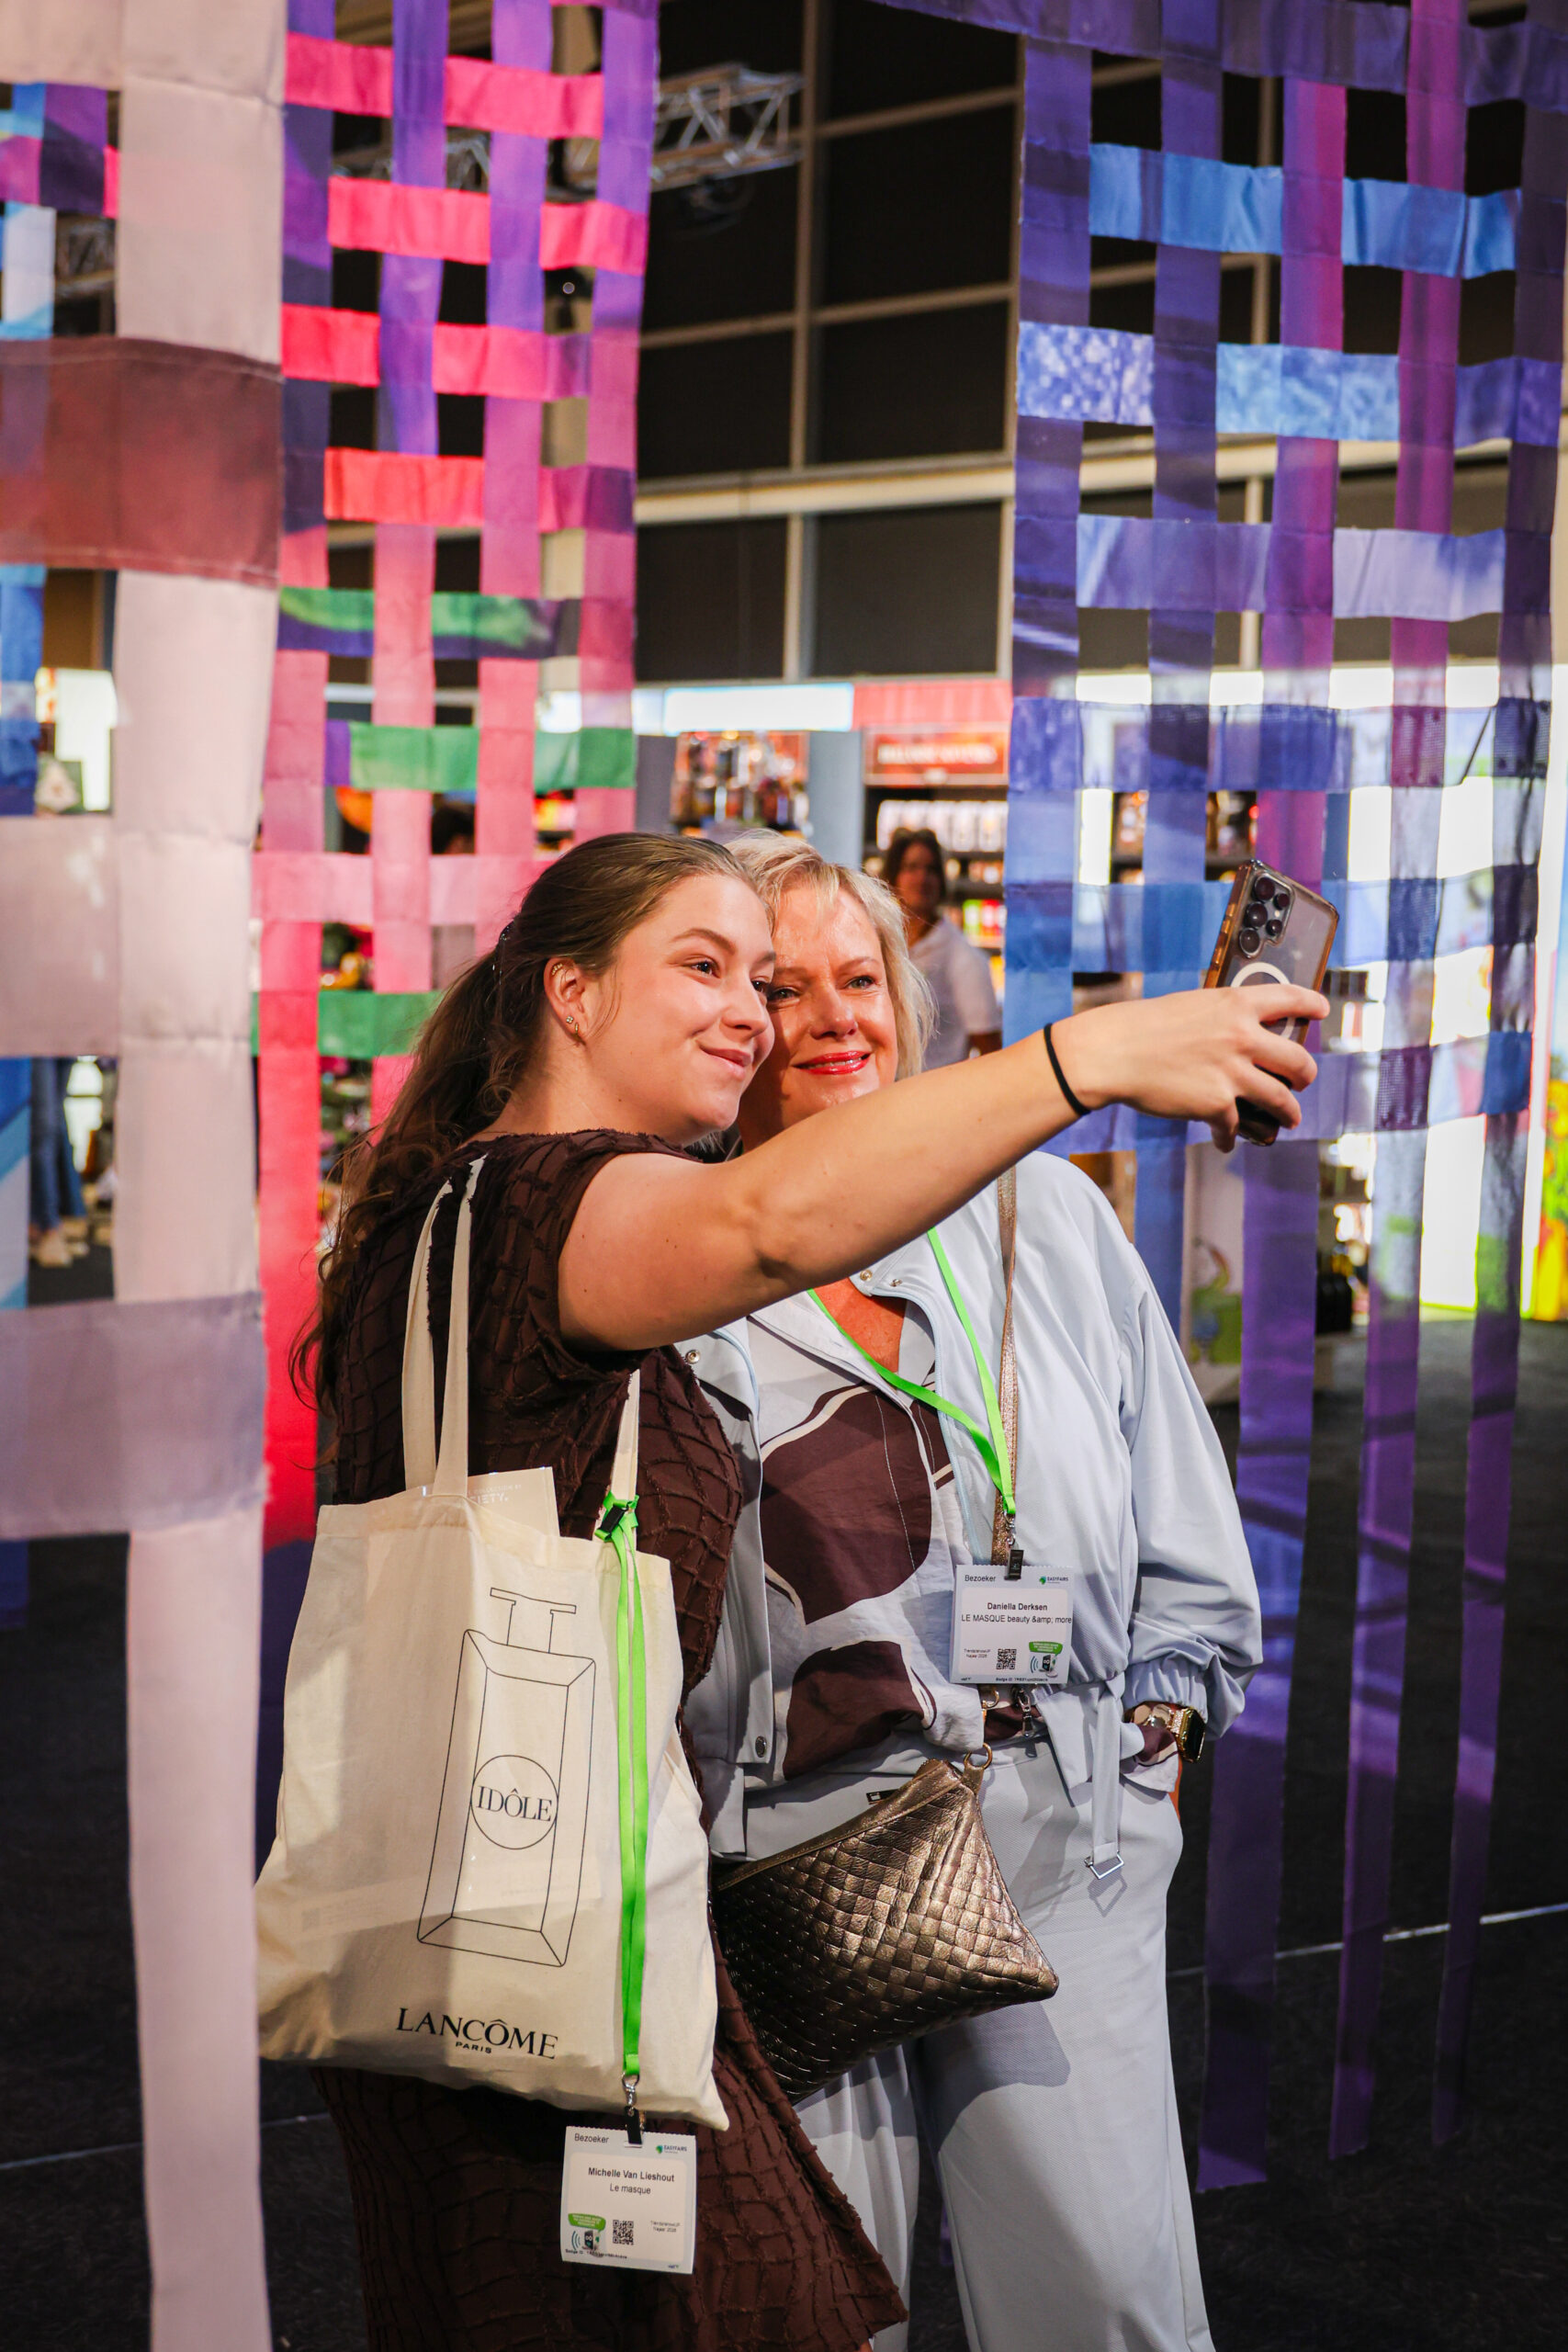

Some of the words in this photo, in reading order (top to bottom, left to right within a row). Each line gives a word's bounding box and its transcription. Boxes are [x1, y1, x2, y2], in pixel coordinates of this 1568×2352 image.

[964, 1574, 996, 1582] Bezoeker
[987, 1602, 1016, 1611] Daniella
[1018, 1602, 1047, 1611] Derksen
[973, 1614, 1005, 1623] MASQUE
[1007, 1615, 1030, 1623] beauty
[1032, 1615, 1054, 1624] &amp;
[476, 1785, 553, 1822] IDÔLE
[396, 2007, 558, 2060] LANCÔME
[455, 2041, 492, 2054] PARIS
[574, 2132, 609, 2143] Bezoeker
[588, 2166, 621, 2178] Michelle
[623, 2170, 637, 2179] Van
[640, 2171, 675, 2182] Lieshout
[609, 2183, 619, 2192] Le
[621, 2185, 651, 2196] masque
